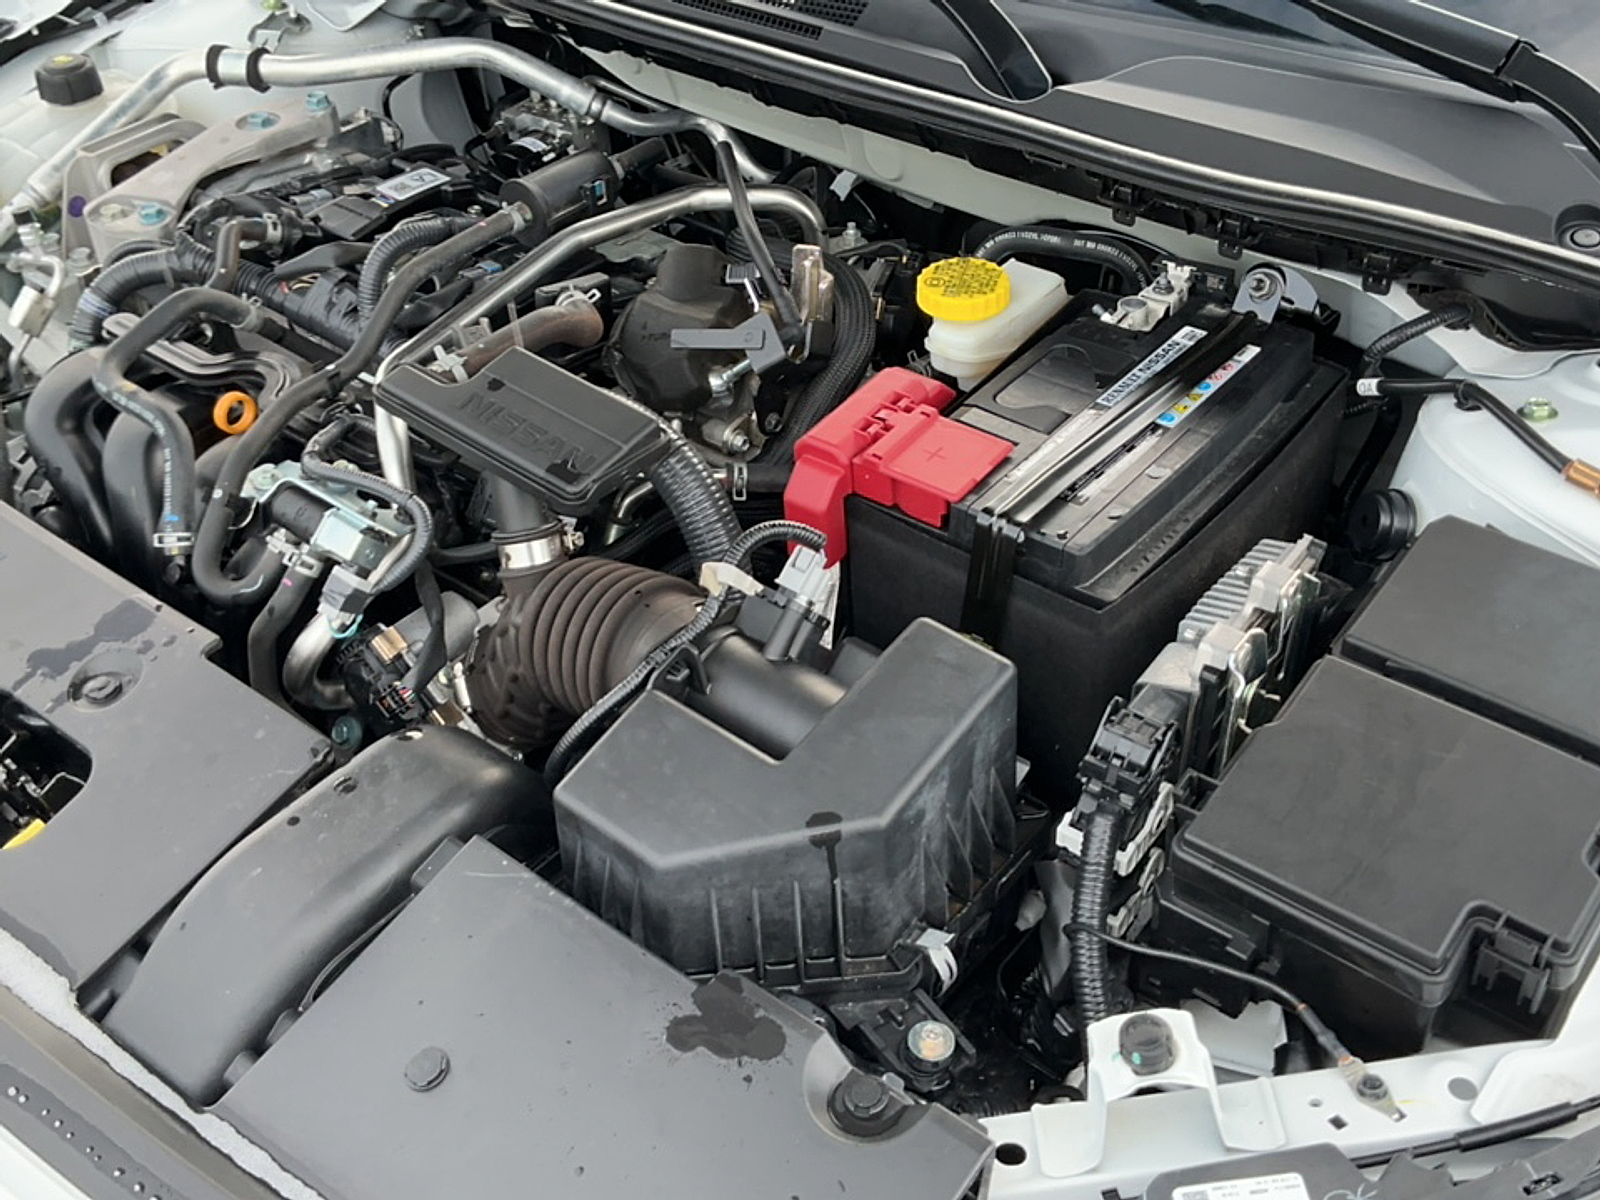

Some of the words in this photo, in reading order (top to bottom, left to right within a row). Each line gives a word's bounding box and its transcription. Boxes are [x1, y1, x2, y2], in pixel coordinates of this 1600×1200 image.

[1100, 373, 1142, 403] RENAULT
[1138, 340, 1181, 375] NISSAN
[456, 391, 598, 473] NISSAN
